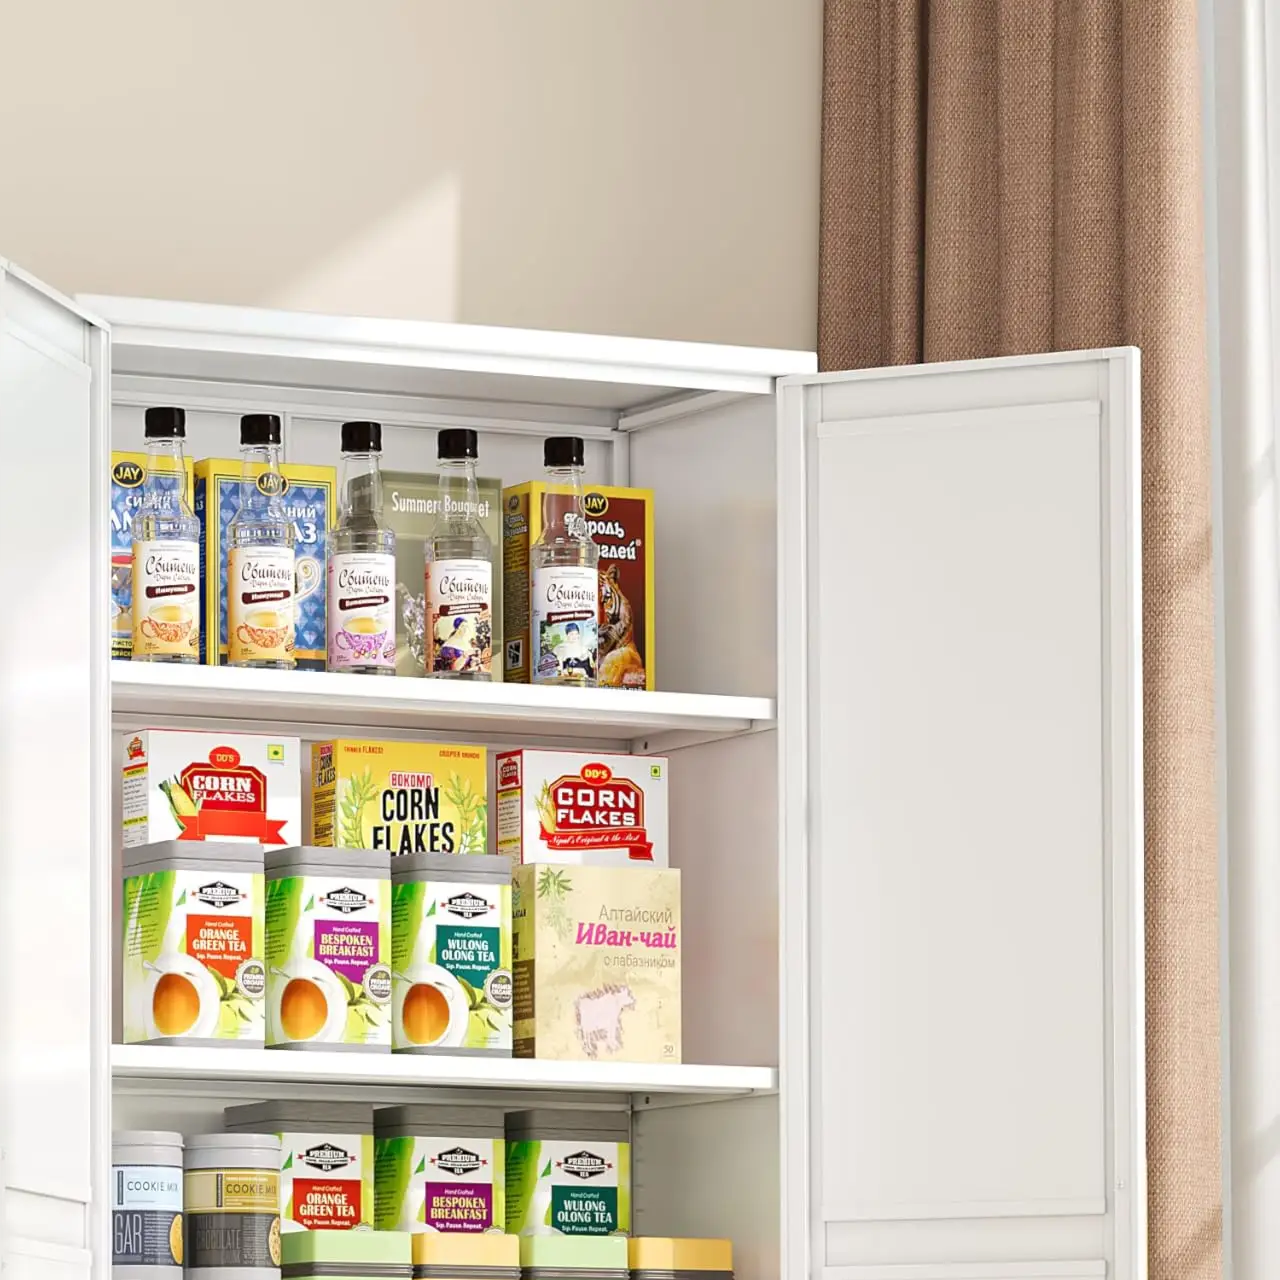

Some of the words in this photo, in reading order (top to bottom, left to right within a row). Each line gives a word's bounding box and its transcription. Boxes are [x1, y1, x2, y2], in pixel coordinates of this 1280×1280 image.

[116, 467, 140, 480] JAY
[392, 491, 437, 514] Summer
[585, 497, 605, 510] JAY
[584, 768, 608, 779] DD'S
[193, 775, 252, 792] CORN
[391, 773, 432, 788] BOKOMO
[193, 790, 256, 803] FLAKES
[556, 787, 636, 809] CORN
[382, 787, 439, 822] CORN
[557, 808, 636, 826] FLAKES
[372, 821, 455, 857] FLAKES
[599, 904, 673, 924] Алтайский
[199, 928, 240, 940] ORANGE
[321, 934, 373, 946] BESPOKEN
[575, 922, 677, 949] Иван-чай
[192, 939, 226, 951] GREEN
[229, 940, 246, 952] TEA
[319, 944, 374, 957] BREAKFAST
[447, 939, 489, 951] WULONG
[441, 950, 474, 961] OLONG
[477, 951, 495, 962] TEA
[613, 954, 675, 968] лабазником
[127, 1181, 165, 1192] COOKIE
[226, 1183, 264, 1194] COOKIE
[306, 1193, 348, 1205] ORANGE
[432, 1196, 486, 1209] BESPOKEN
[563, 1200, 606, 1211] WULONG
[299, 1204, 333, 1217] GREEN
[337, 1205, 355, 1217] TEA
[430, 1207, 488, 1220] BREAKFAST
[557, 1211, 591, 1223] OLONG
[594, 1212, 612, 1223] TEA
[114, 1213, 142, 1254] GAR
